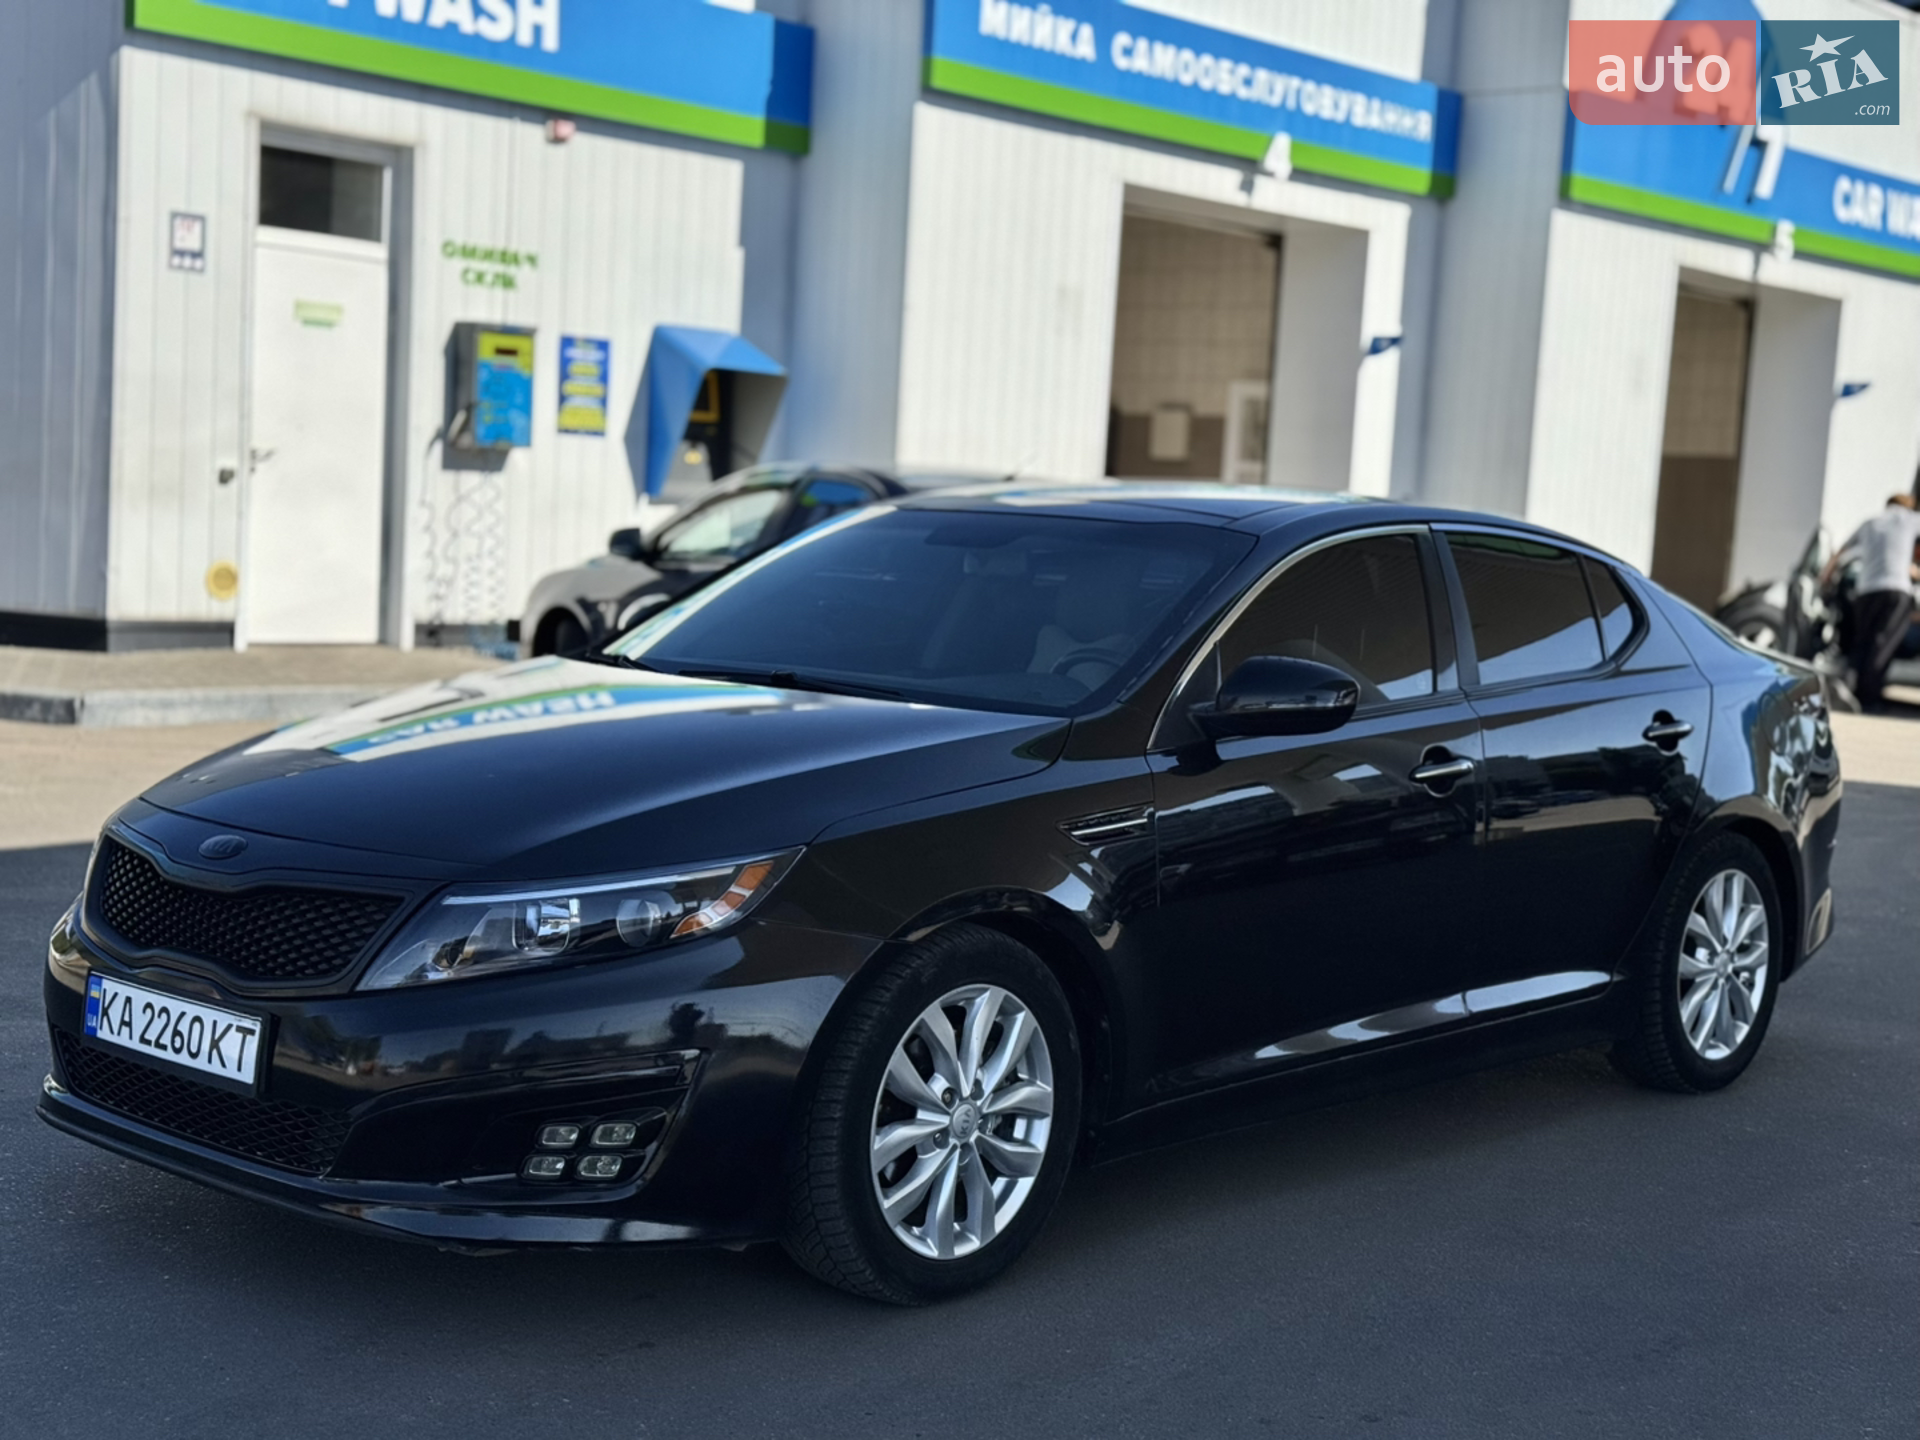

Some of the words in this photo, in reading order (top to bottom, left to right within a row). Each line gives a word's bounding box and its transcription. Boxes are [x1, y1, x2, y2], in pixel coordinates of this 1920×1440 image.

[977, 0, 1098, 63] МИЙКА
[1111, 31, 1433, 143] САМООБСЛУГОВУВАННЯ
[1263, 131, 1293, 181] 4
[1832, 173, 1887, 232] CAR
